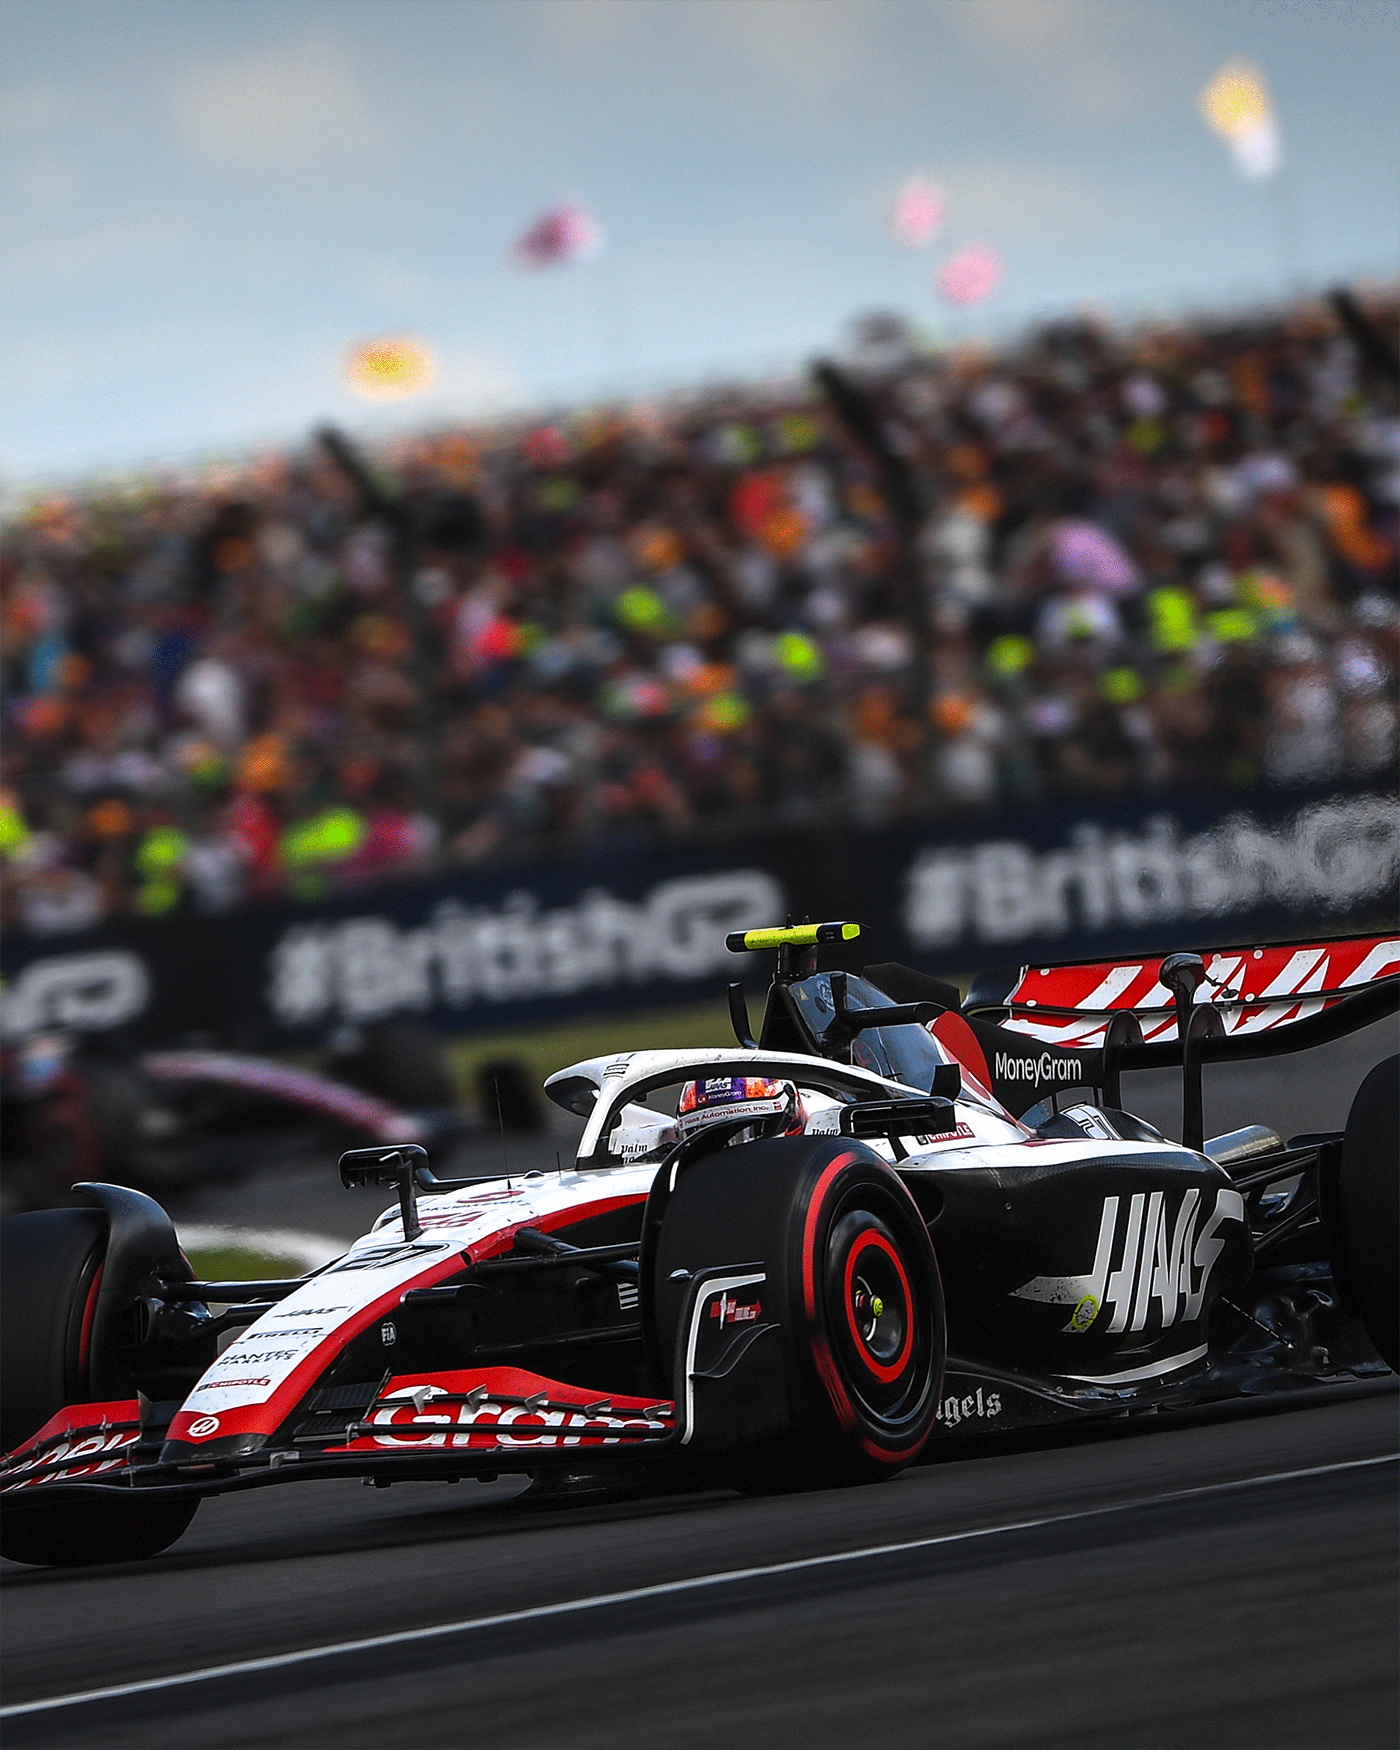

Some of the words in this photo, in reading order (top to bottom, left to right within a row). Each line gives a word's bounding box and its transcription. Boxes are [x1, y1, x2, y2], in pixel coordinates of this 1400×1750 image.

[995, 1051, 1082, 1088] MoneyGram
[1008, 1188, 1245, 1334] HAAS
[247, 1327, 324, 1341] PIRELLI
[217, 1353, 296, 1367] MARKETS
[222, 1350, 299, 1362] HANTEC
[209, 1378, 269, 1389] CHIPOTLE
[935, 1387, 1002, 1428] gels
